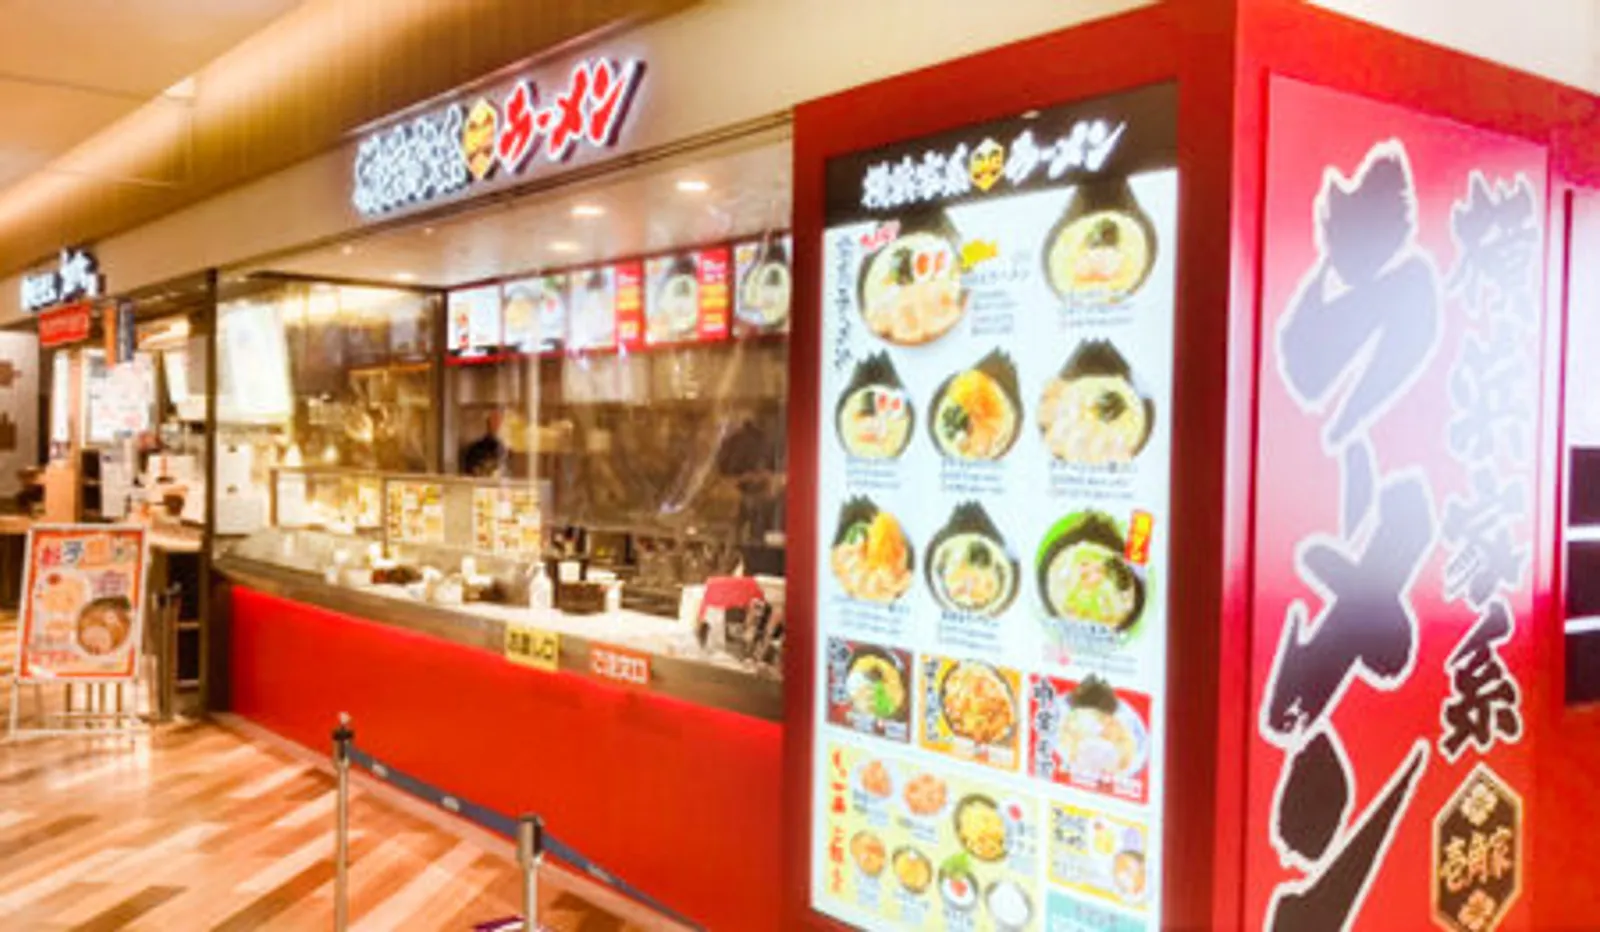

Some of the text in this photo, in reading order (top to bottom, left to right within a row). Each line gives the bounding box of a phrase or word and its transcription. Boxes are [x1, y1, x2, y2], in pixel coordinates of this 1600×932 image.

[499, 58, 638, 174] ラーメン
[1004, 119, 1127, 186] ラーメン
[1259, 138, 1443, 932] ラーメン
[1440, 826, 1514, 893] 壱角家
